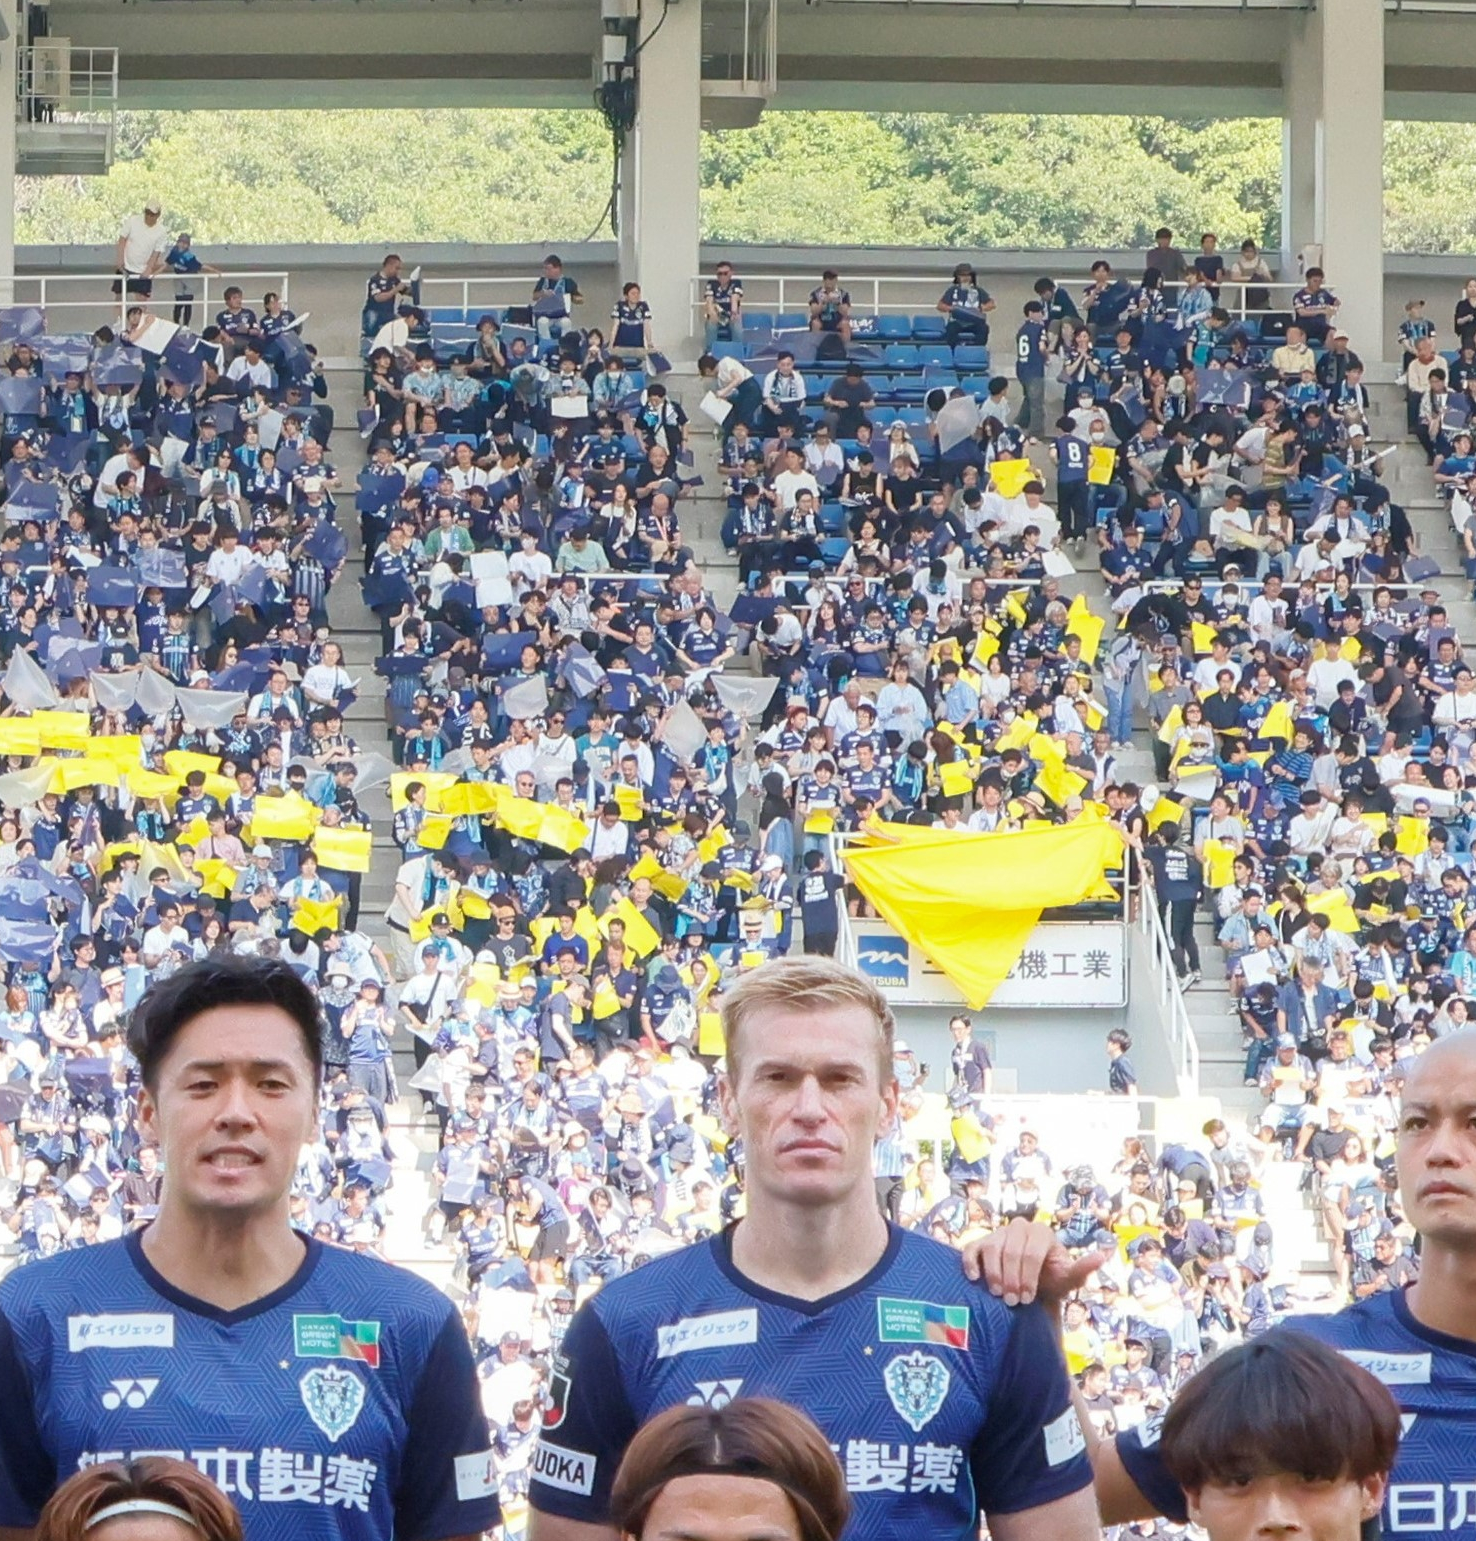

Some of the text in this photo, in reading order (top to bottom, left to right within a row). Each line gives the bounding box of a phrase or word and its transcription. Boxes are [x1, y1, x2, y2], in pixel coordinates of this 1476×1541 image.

[1003, 949, 1112, 980] 機工業
[93, 1323, 166, 1337] エイジェック
[677, 1318, 751, 1340] エイジェック
[77, 1447, 379, 1512] 本製薬
